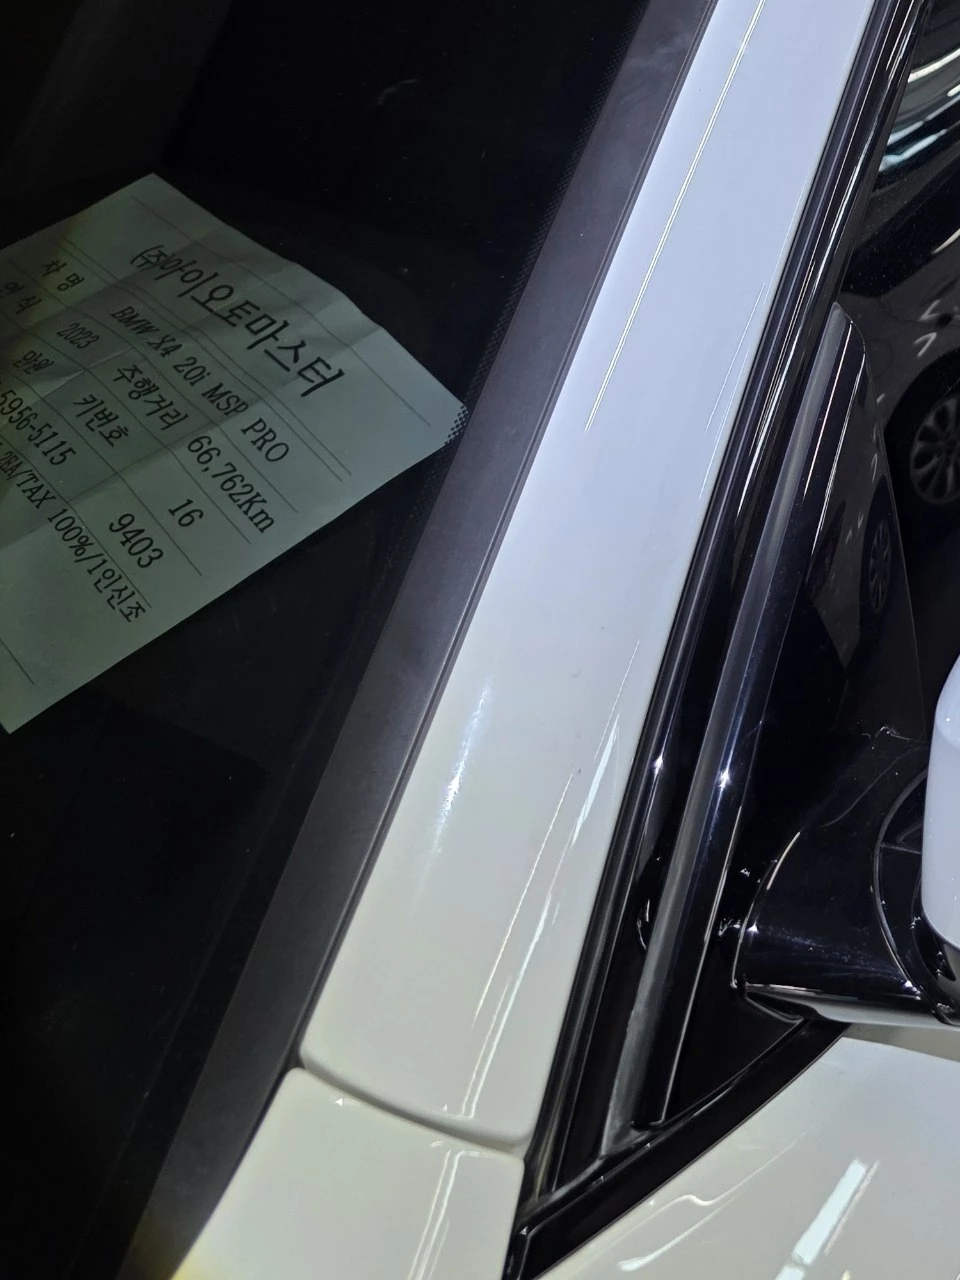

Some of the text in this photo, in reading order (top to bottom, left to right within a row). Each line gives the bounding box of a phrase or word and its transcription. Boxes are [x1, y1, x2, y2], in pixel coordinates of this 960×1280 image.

[56, 322, 99, 349] 2023
[110, 306, 290, 462] BMW X4 20i MSP PRO
[113, 365, 189, 430] 주행거리
[73, 394, 129, 447] 키번호
[168, 499, 204, 527] 16
[187, 435, 275, 533] 66,762Km
[48, 507, 146, 623] 100%/1인신조
[109, 513, 163, 569] 9403
